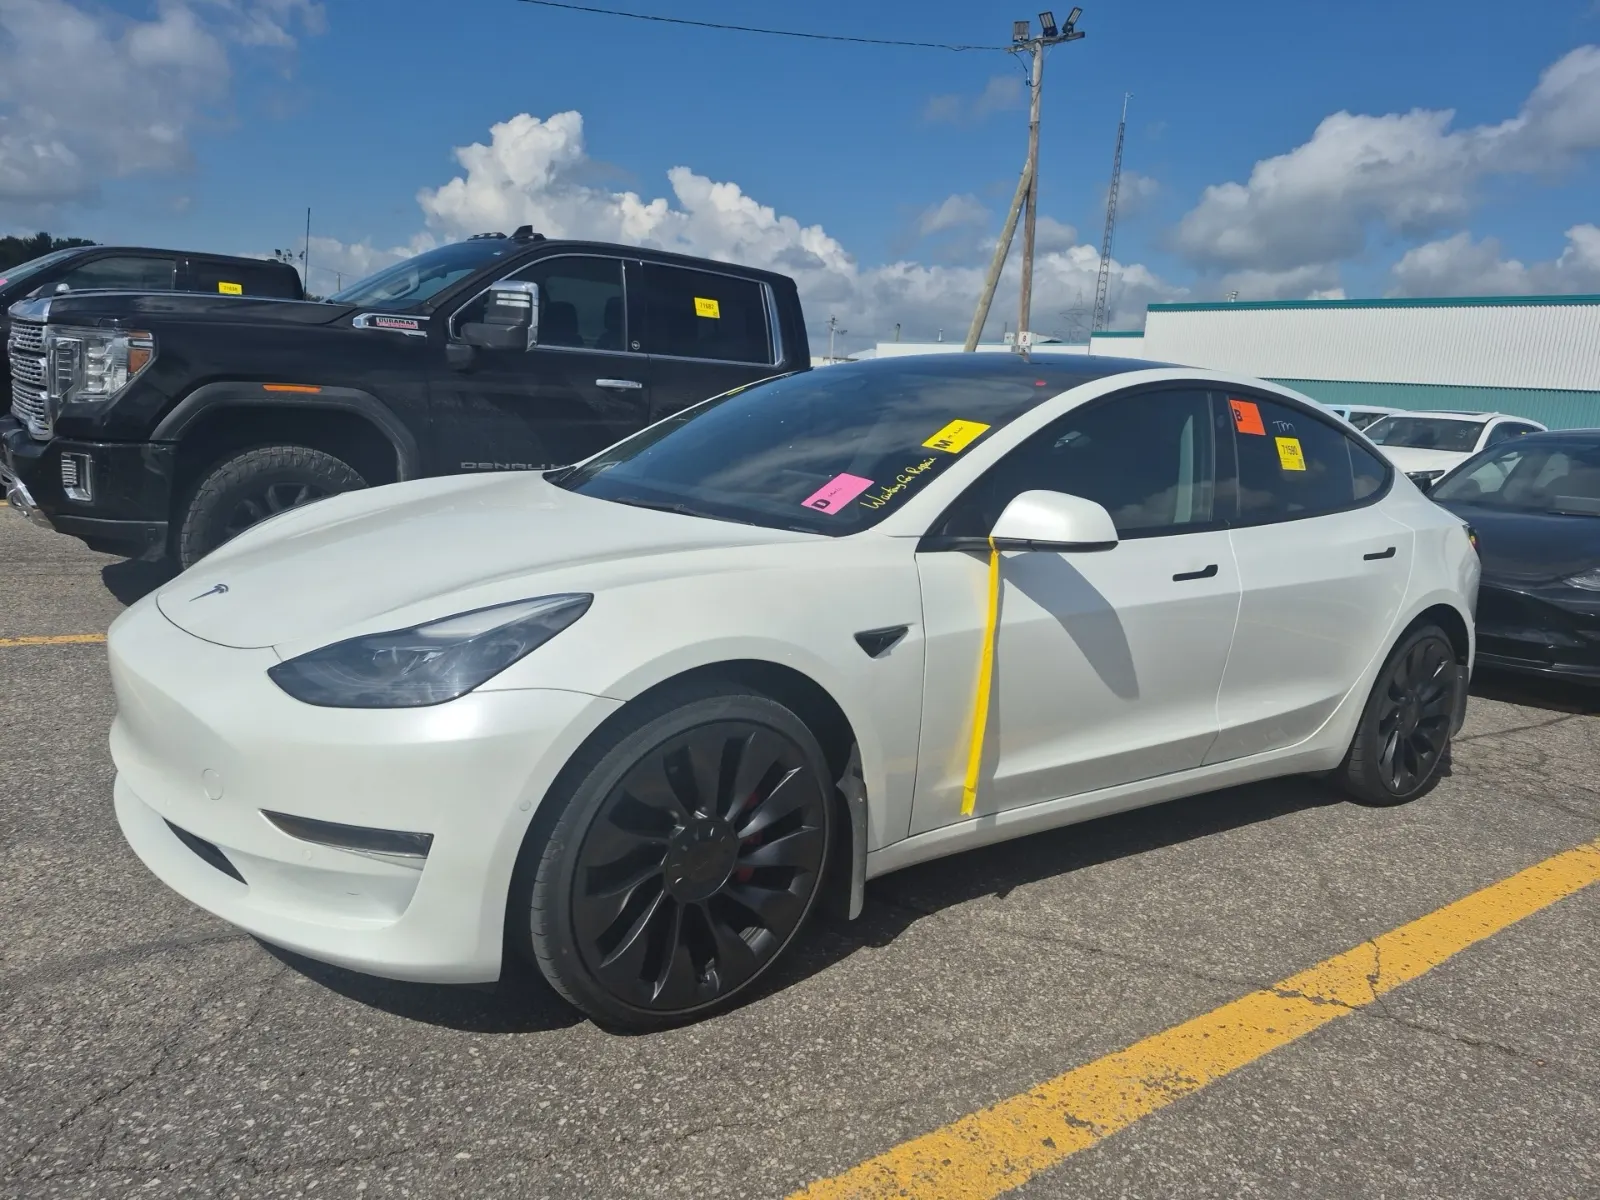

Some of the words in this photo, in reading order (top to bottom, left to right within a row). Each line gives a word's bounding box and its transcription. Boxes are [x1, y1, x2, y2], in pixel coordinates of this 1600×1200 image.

[378, 317, 416, 325] DURAMAX
[1234, 409, 1243, 421] B
[933, 439, 954, 449] M
[460, 461, 545, 470] DENALI
[811, 498, 831, 510] D
